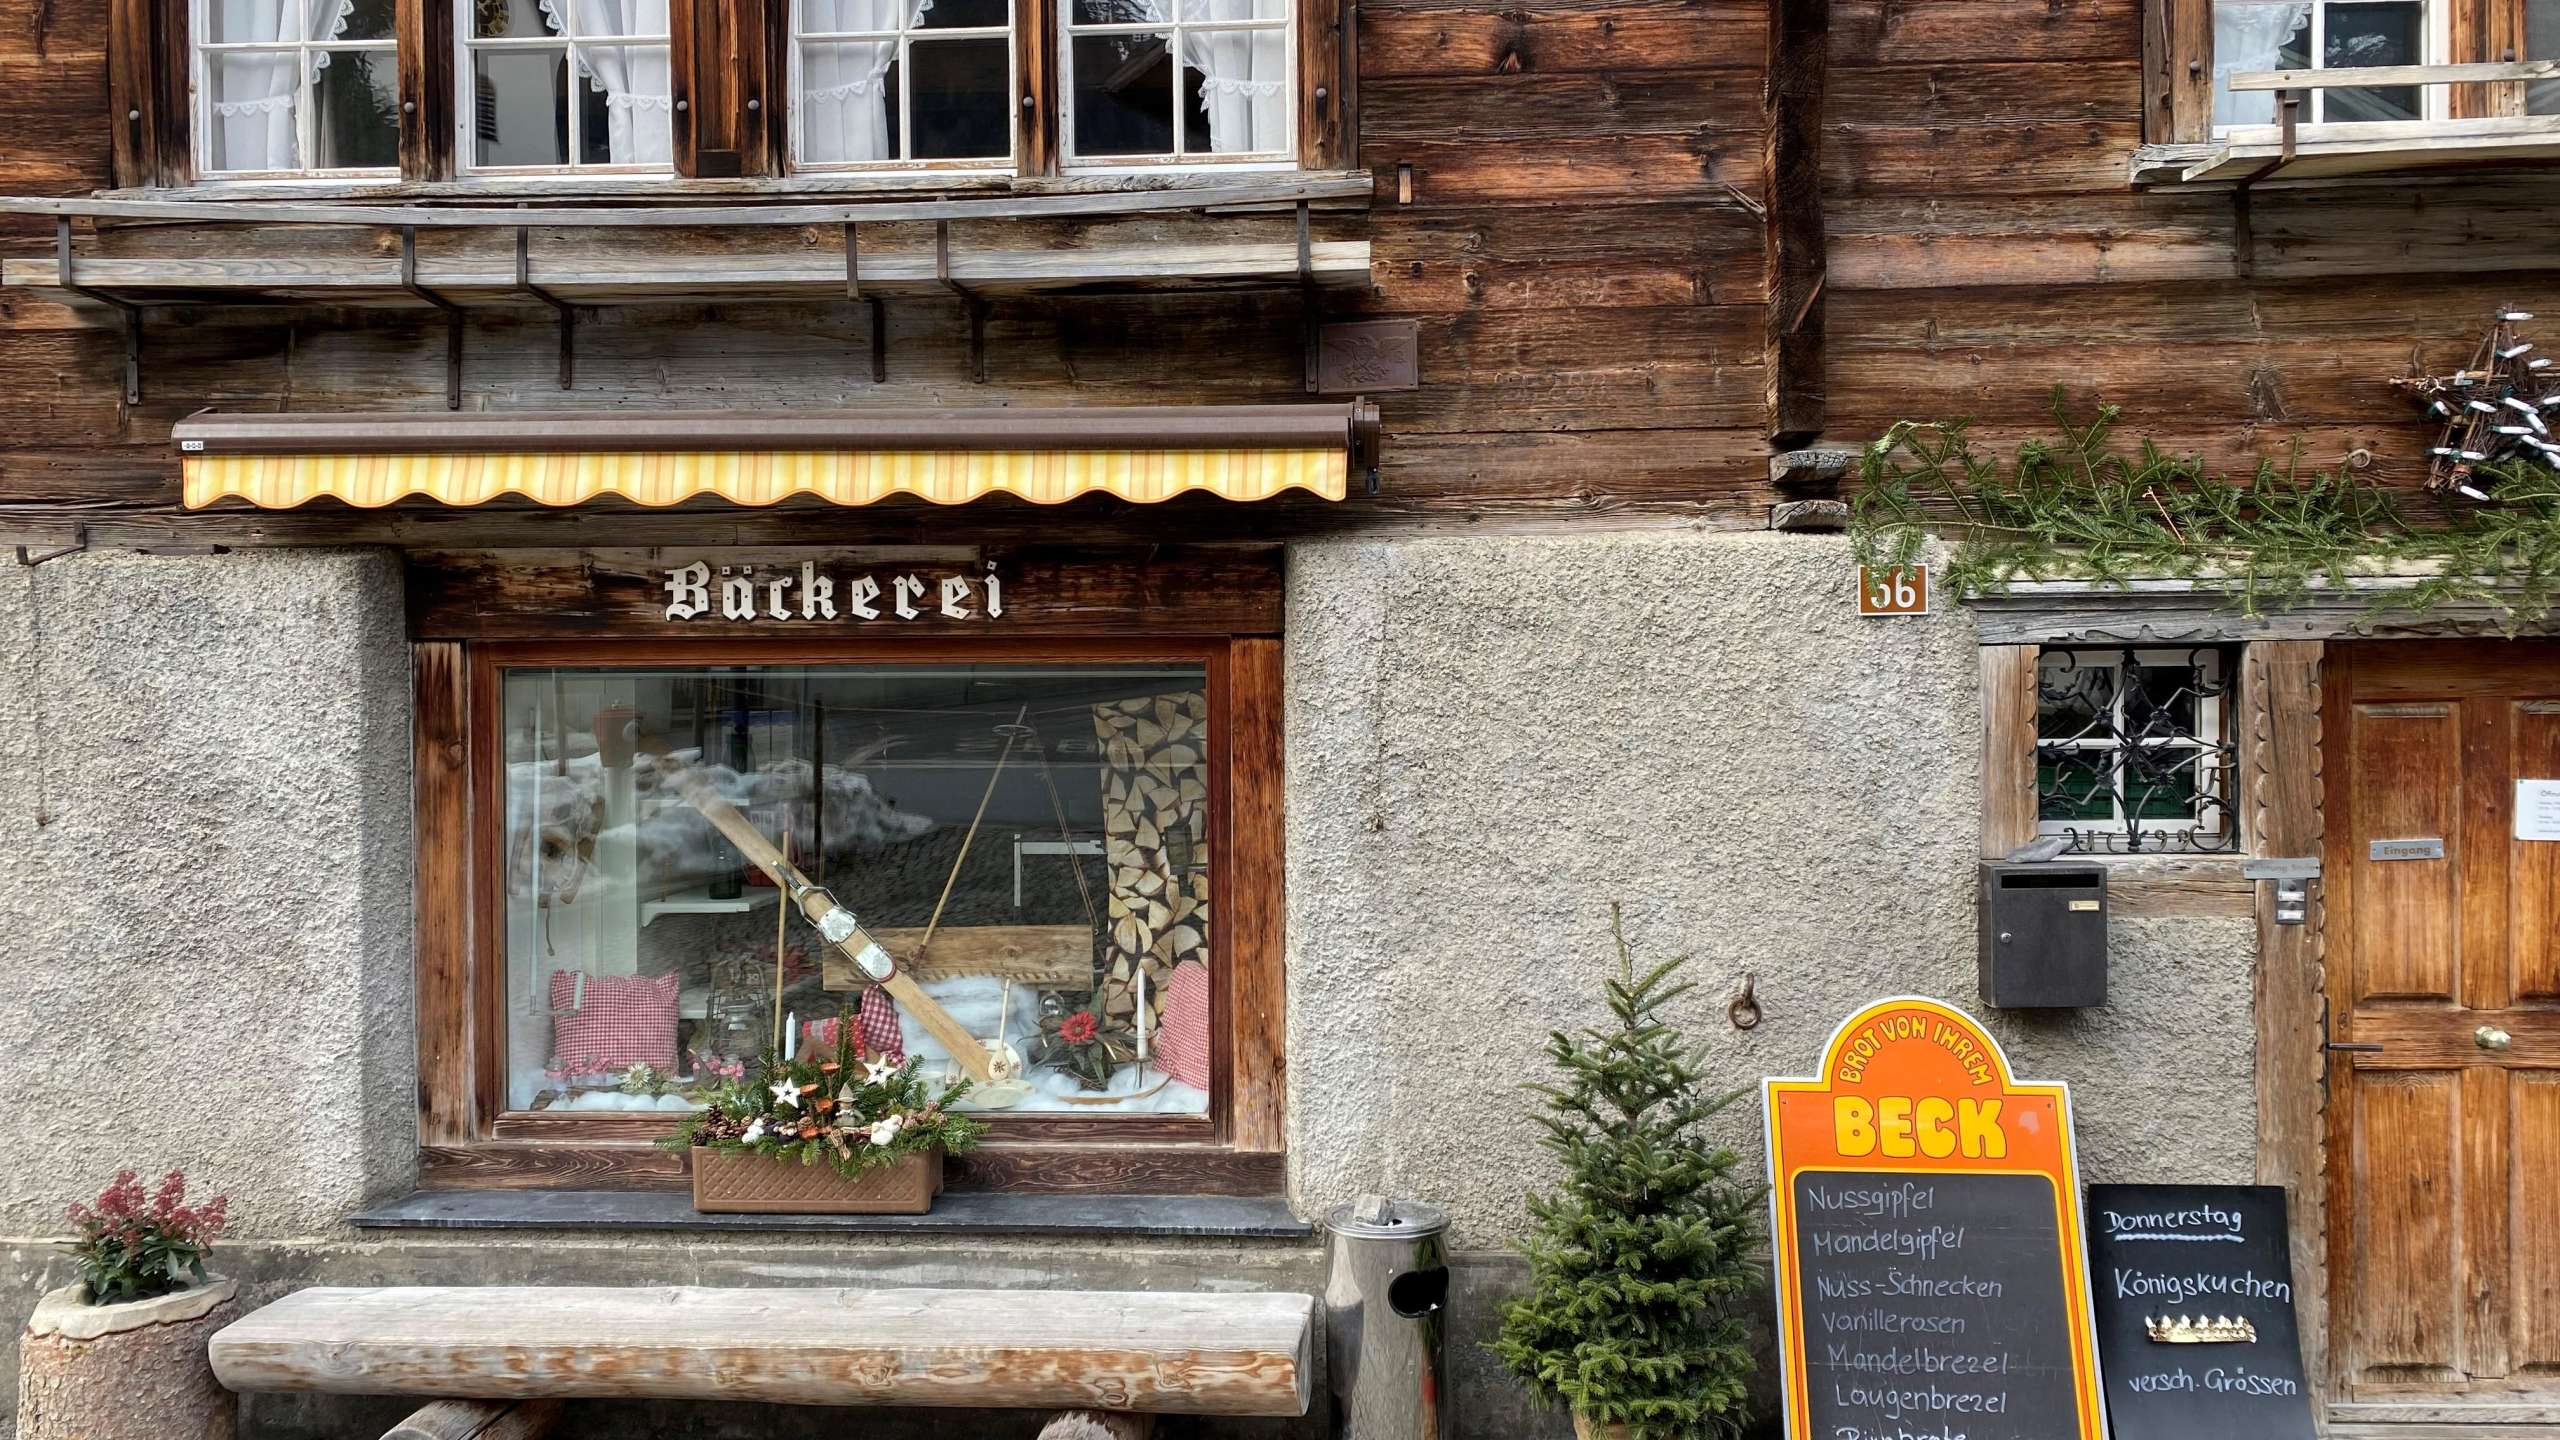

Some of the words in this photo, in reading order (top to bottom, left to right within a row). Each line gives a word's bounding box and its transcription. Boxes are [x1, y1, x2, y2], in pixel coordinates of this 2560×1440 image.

[664, 561, 1002, 620] Bäckerei
[1870, 570, 1916, 609] 56
[2383, 846, 2432, 857] Eingang
[1839, 1028, 1883, 1083] BROT
[1879, 1015, 1928, 1042] VON
[1932, 1022, 1994, 1086] IHREM
[1833, 1095, 2008, 1159] BECK
[1808, 1182, 1934, 1218] Nussgipfel
[2104, 1204, 2243, 1233] Donnerstag
[1813, 1225, 1965, 1261] Mandelgipfel
[2114, 1268, 2291, 1305] Königskuchen
[1827, 1343, 2009, 1375] Mandelbrezel
[2129, 1368, 2201, 1392] versch.
[2205, 1366, 2297, 1396] Grössen
[1835, 1384, 2007, 1420] Laugenbrezel
